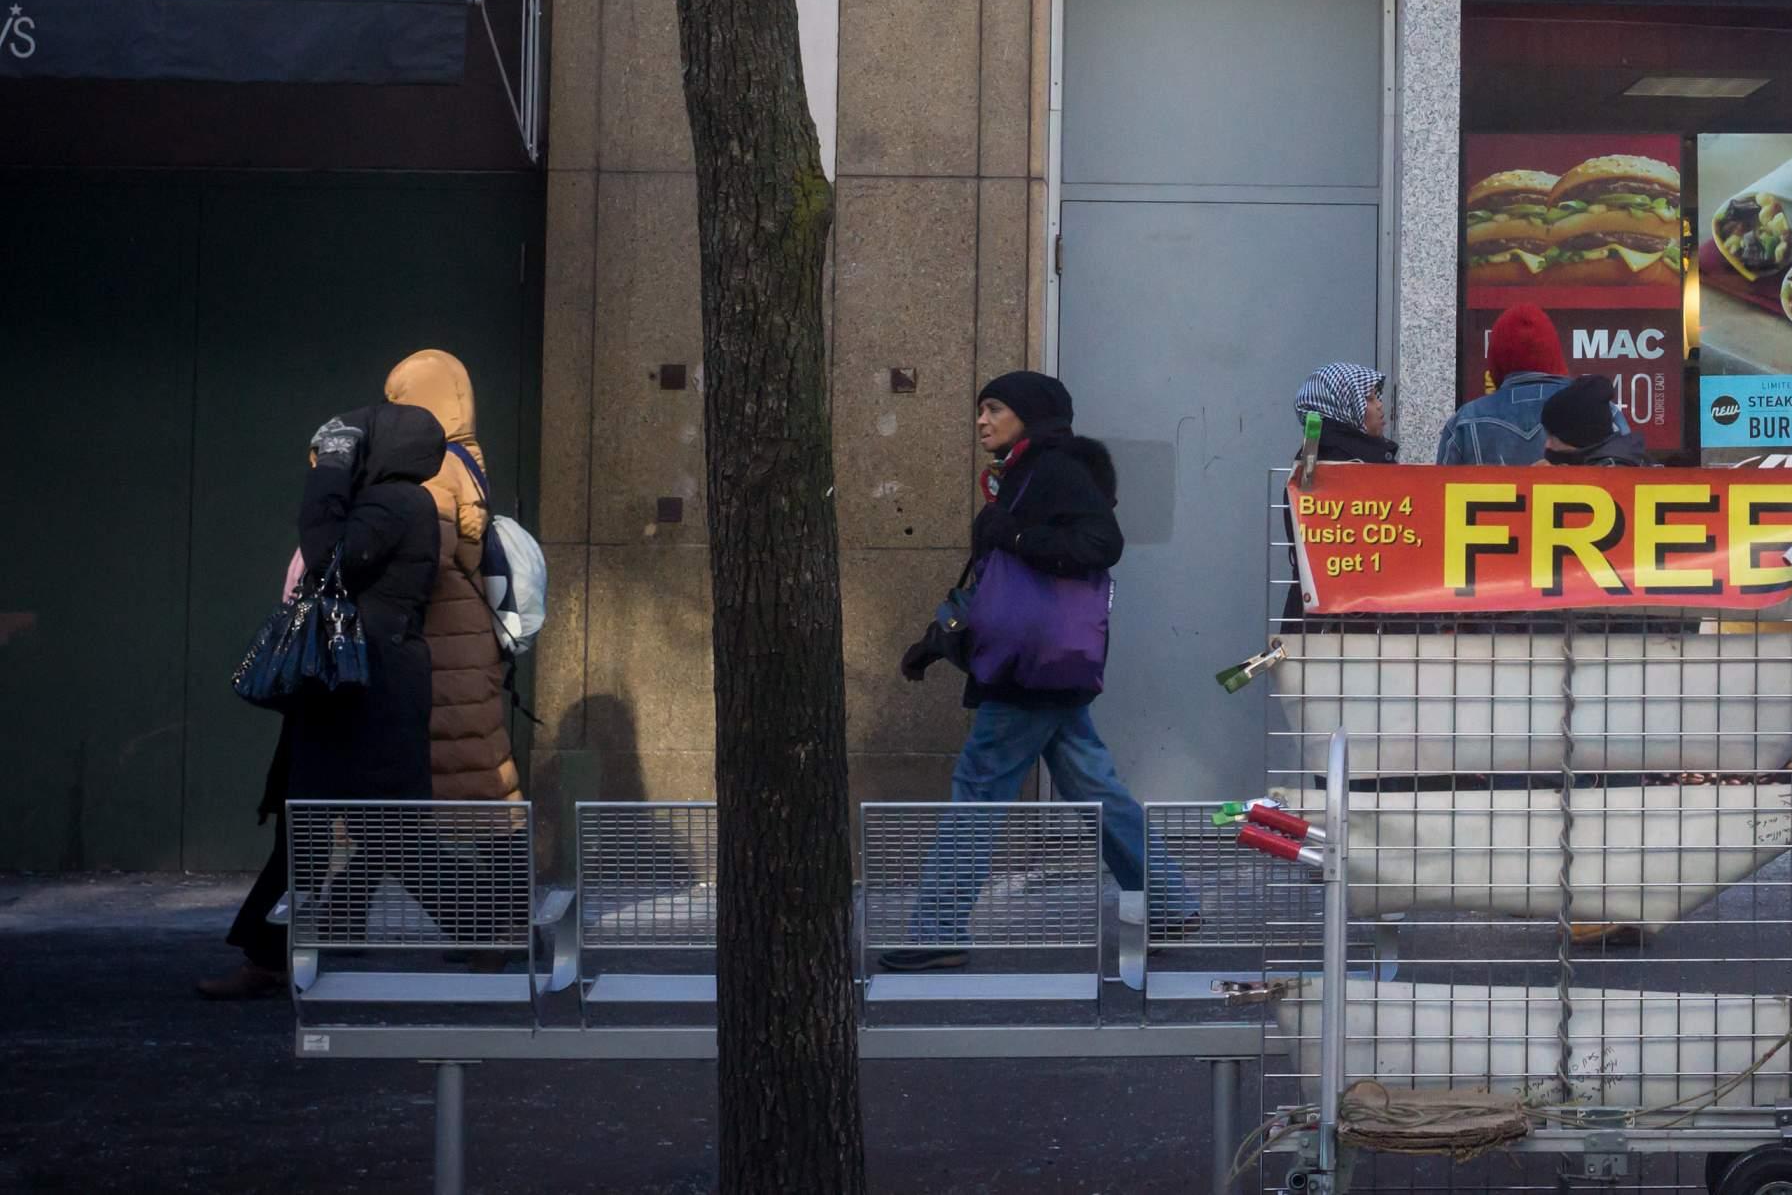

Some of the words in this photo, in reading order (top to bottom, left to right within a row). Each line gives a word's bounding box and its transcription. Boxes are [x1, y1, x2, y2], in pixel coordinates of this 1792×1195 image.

[1573, 329, 1664, 359] MAC
[1748, 396, 1792, 407] STEAK
[1299, 496, 1344, 520] Buy
[1351, 500, 1392, 520] any
[1399, 496, 1412, 515] 4
[1362, 524, 1422, 547] CD's,
[1327, 552, 1363, 576] get
[1370, 552, 1381, 572] 1
